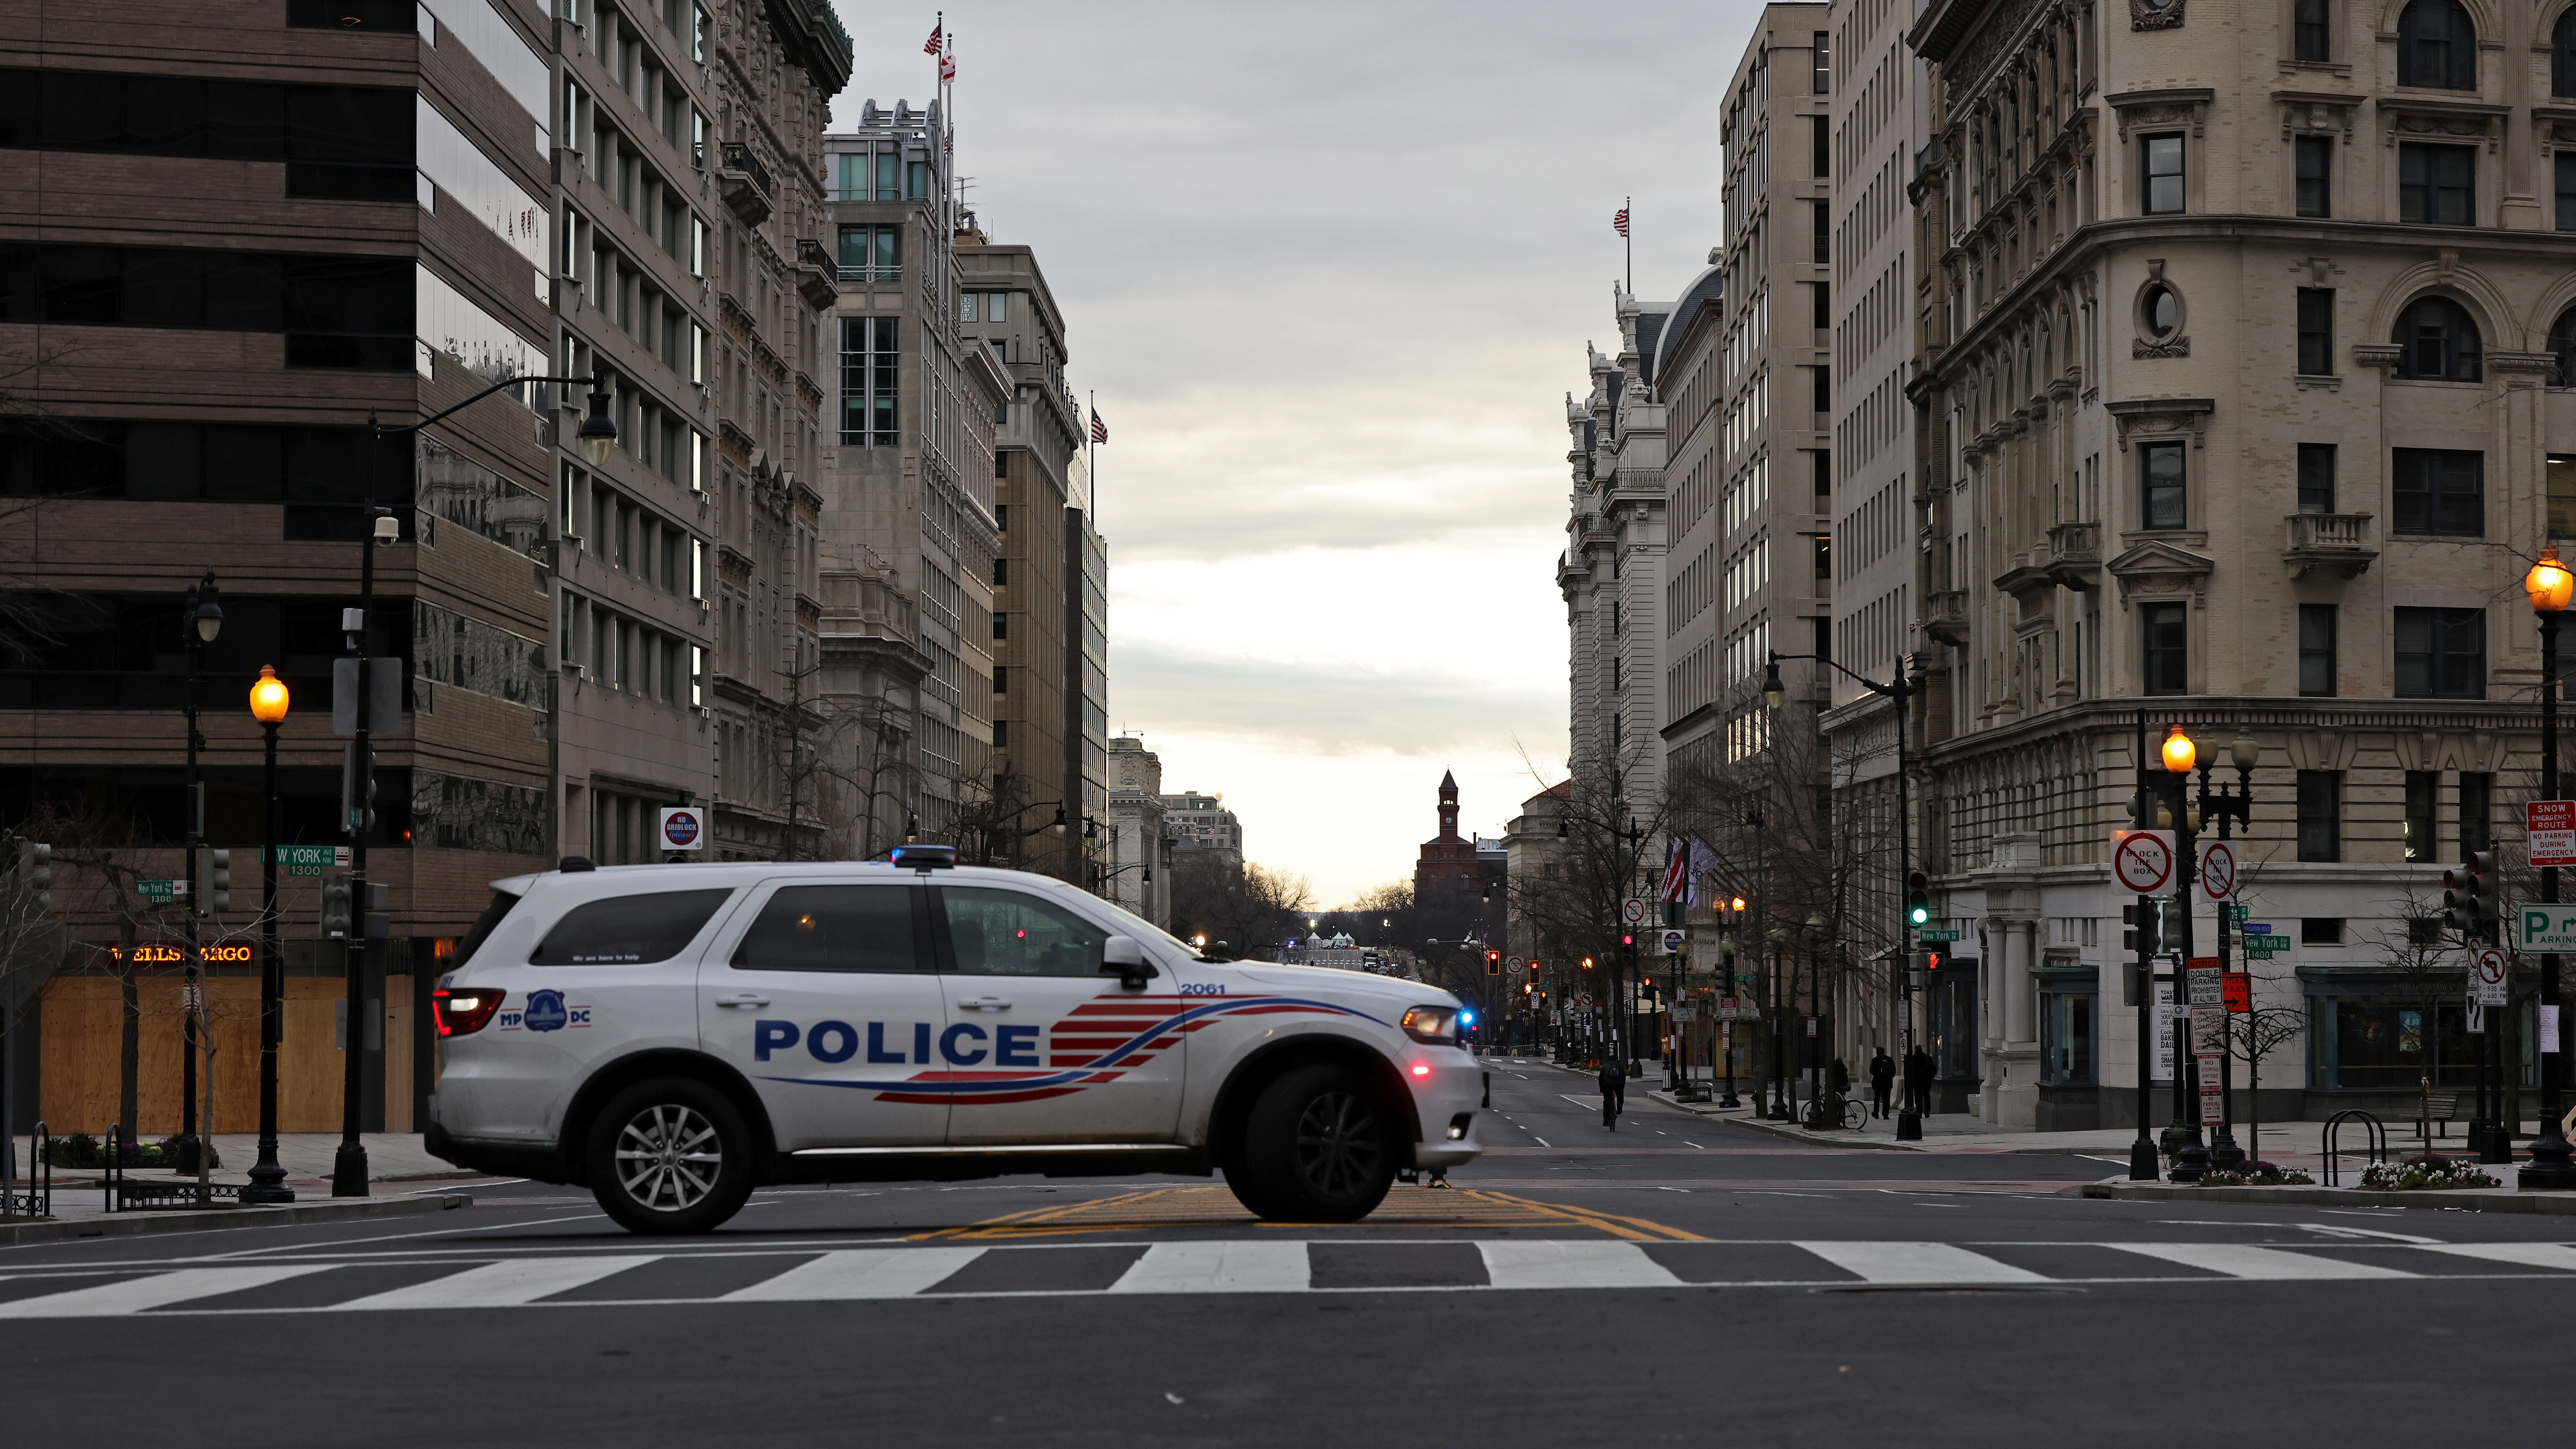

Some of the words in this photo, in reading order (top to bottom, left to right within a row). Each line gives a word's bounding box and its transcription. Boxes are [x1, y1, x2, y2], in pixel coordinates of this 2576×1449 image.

[2537, 805, 2565, 813] SNOW
[292, 849, 321, 863] YORK
[291, 866, 320, 876] 1300
[139, 883, 149, 893] New
[151, 883, 163, 893] York
[1922, 931, 1934, 940] New
[1936, 931, 1949, 940] York
[2244, 937, 2258, 948] New
[2262, 937, 2278, 948] York
[183, 947, 250, 961] ARGO
[2191, 978, 2219, 986] PARKING
[1182, 983, 1225, 995] 2061
[501, 1014, 521, 1026] MP
[571, 1011, 590, 1022] DC
[754, 1020, 1040, 1066] POLICE
